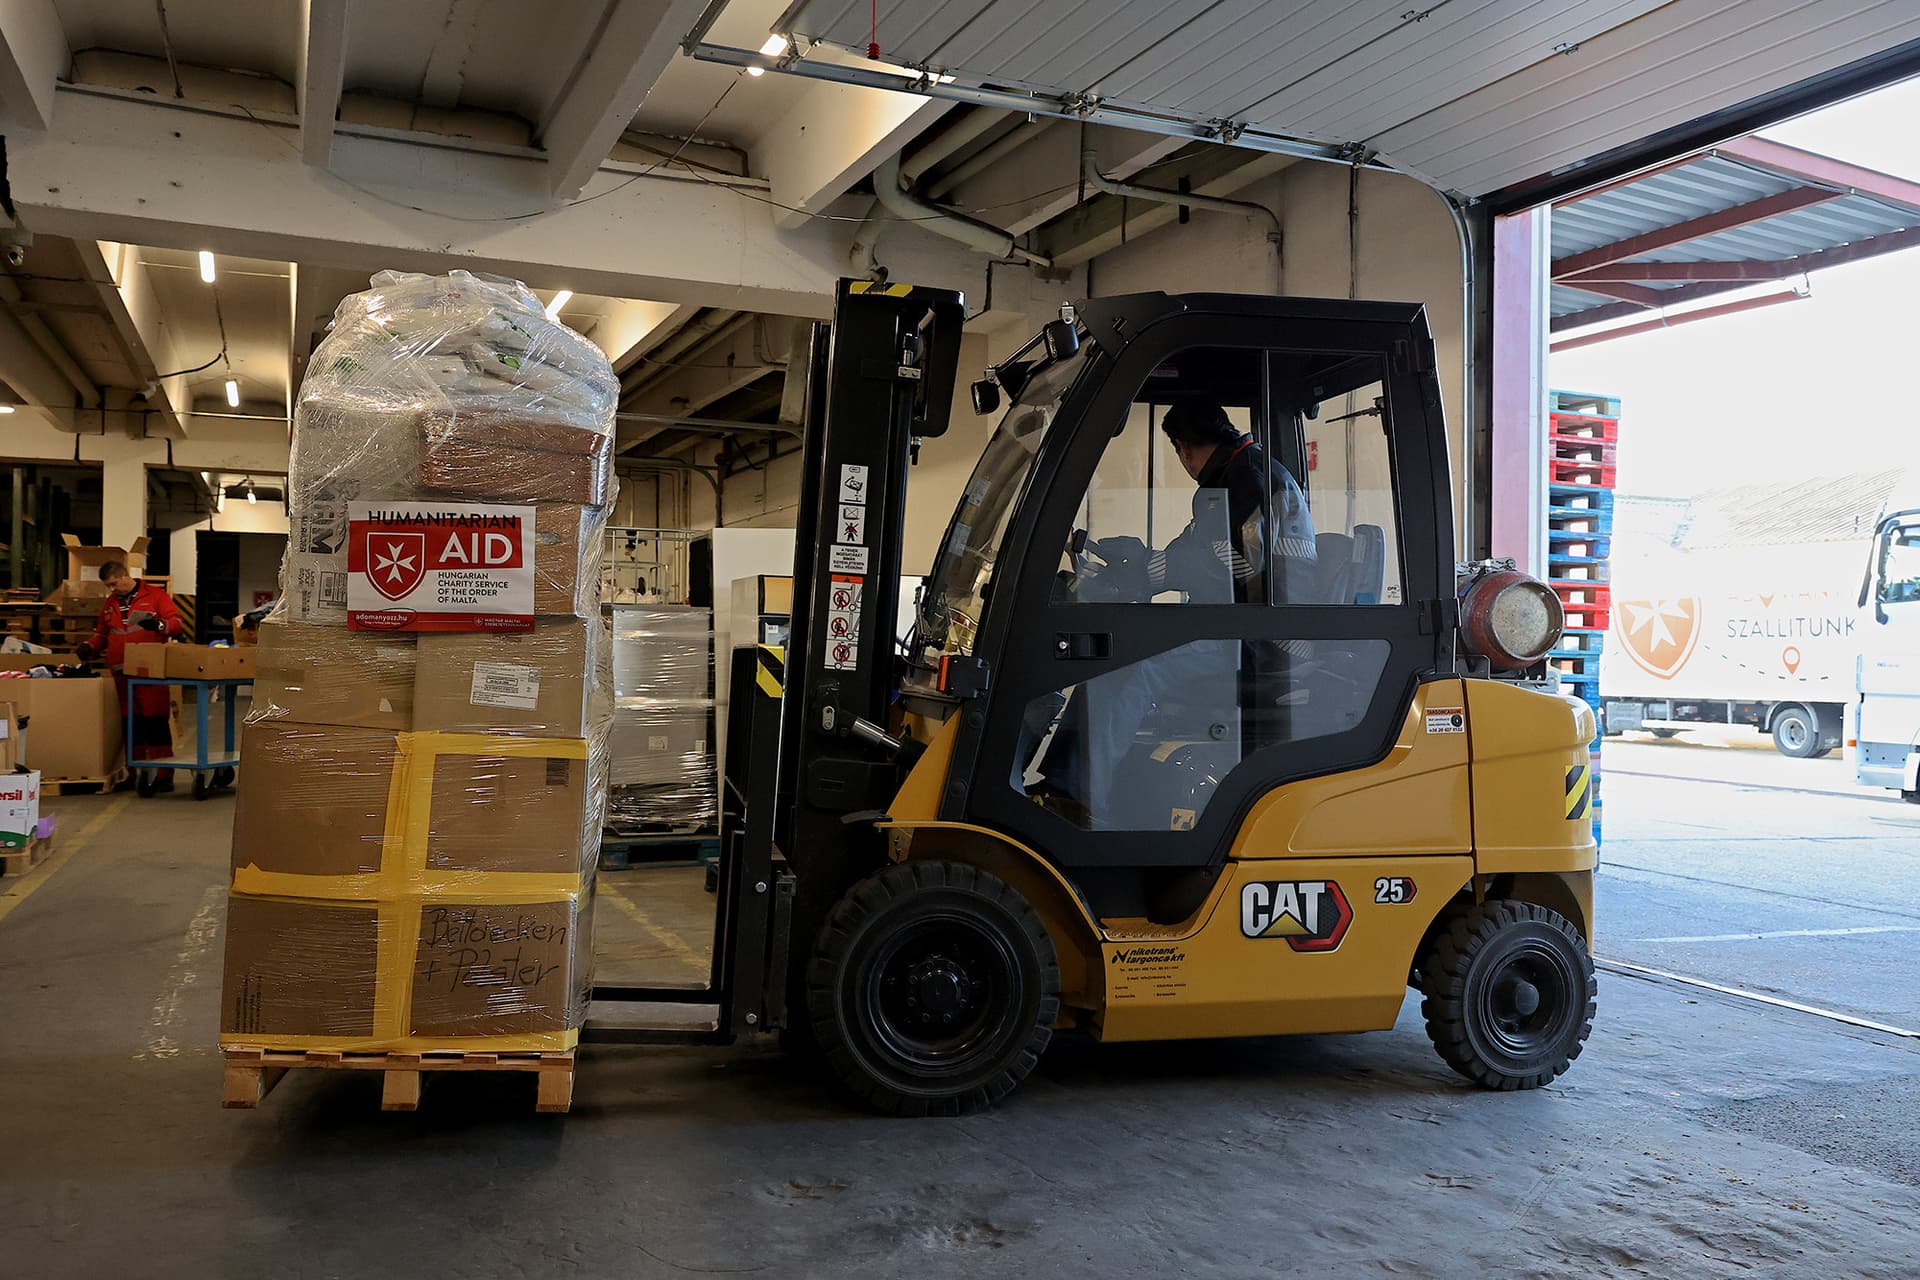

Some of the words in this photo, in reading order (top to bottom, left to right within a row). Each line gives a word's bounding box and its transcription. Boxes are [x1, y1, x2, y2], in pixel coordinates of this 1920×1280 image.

[368, 510, 516, 529] HUMANITARIAN
[438, 531, 513, 565] AID
[438, 572, 489, 580] HUNGARIAN
[438, 580, 474, 588] CHARITY
[475, 581, 509, 589] SERVICE
[438, 588, 449, 596] OF
[451, 588, 467, 596] THE
[468, 588, 498, 597] ORDER
[437, 596, 449, 604] OF
[451, 596, 478, 604] MALTA
[355, 613, 408, 622] adomanyozz.hu
[1375, 878, 1403, 902] 25
[1242, 882, 1326, 937] CAT
